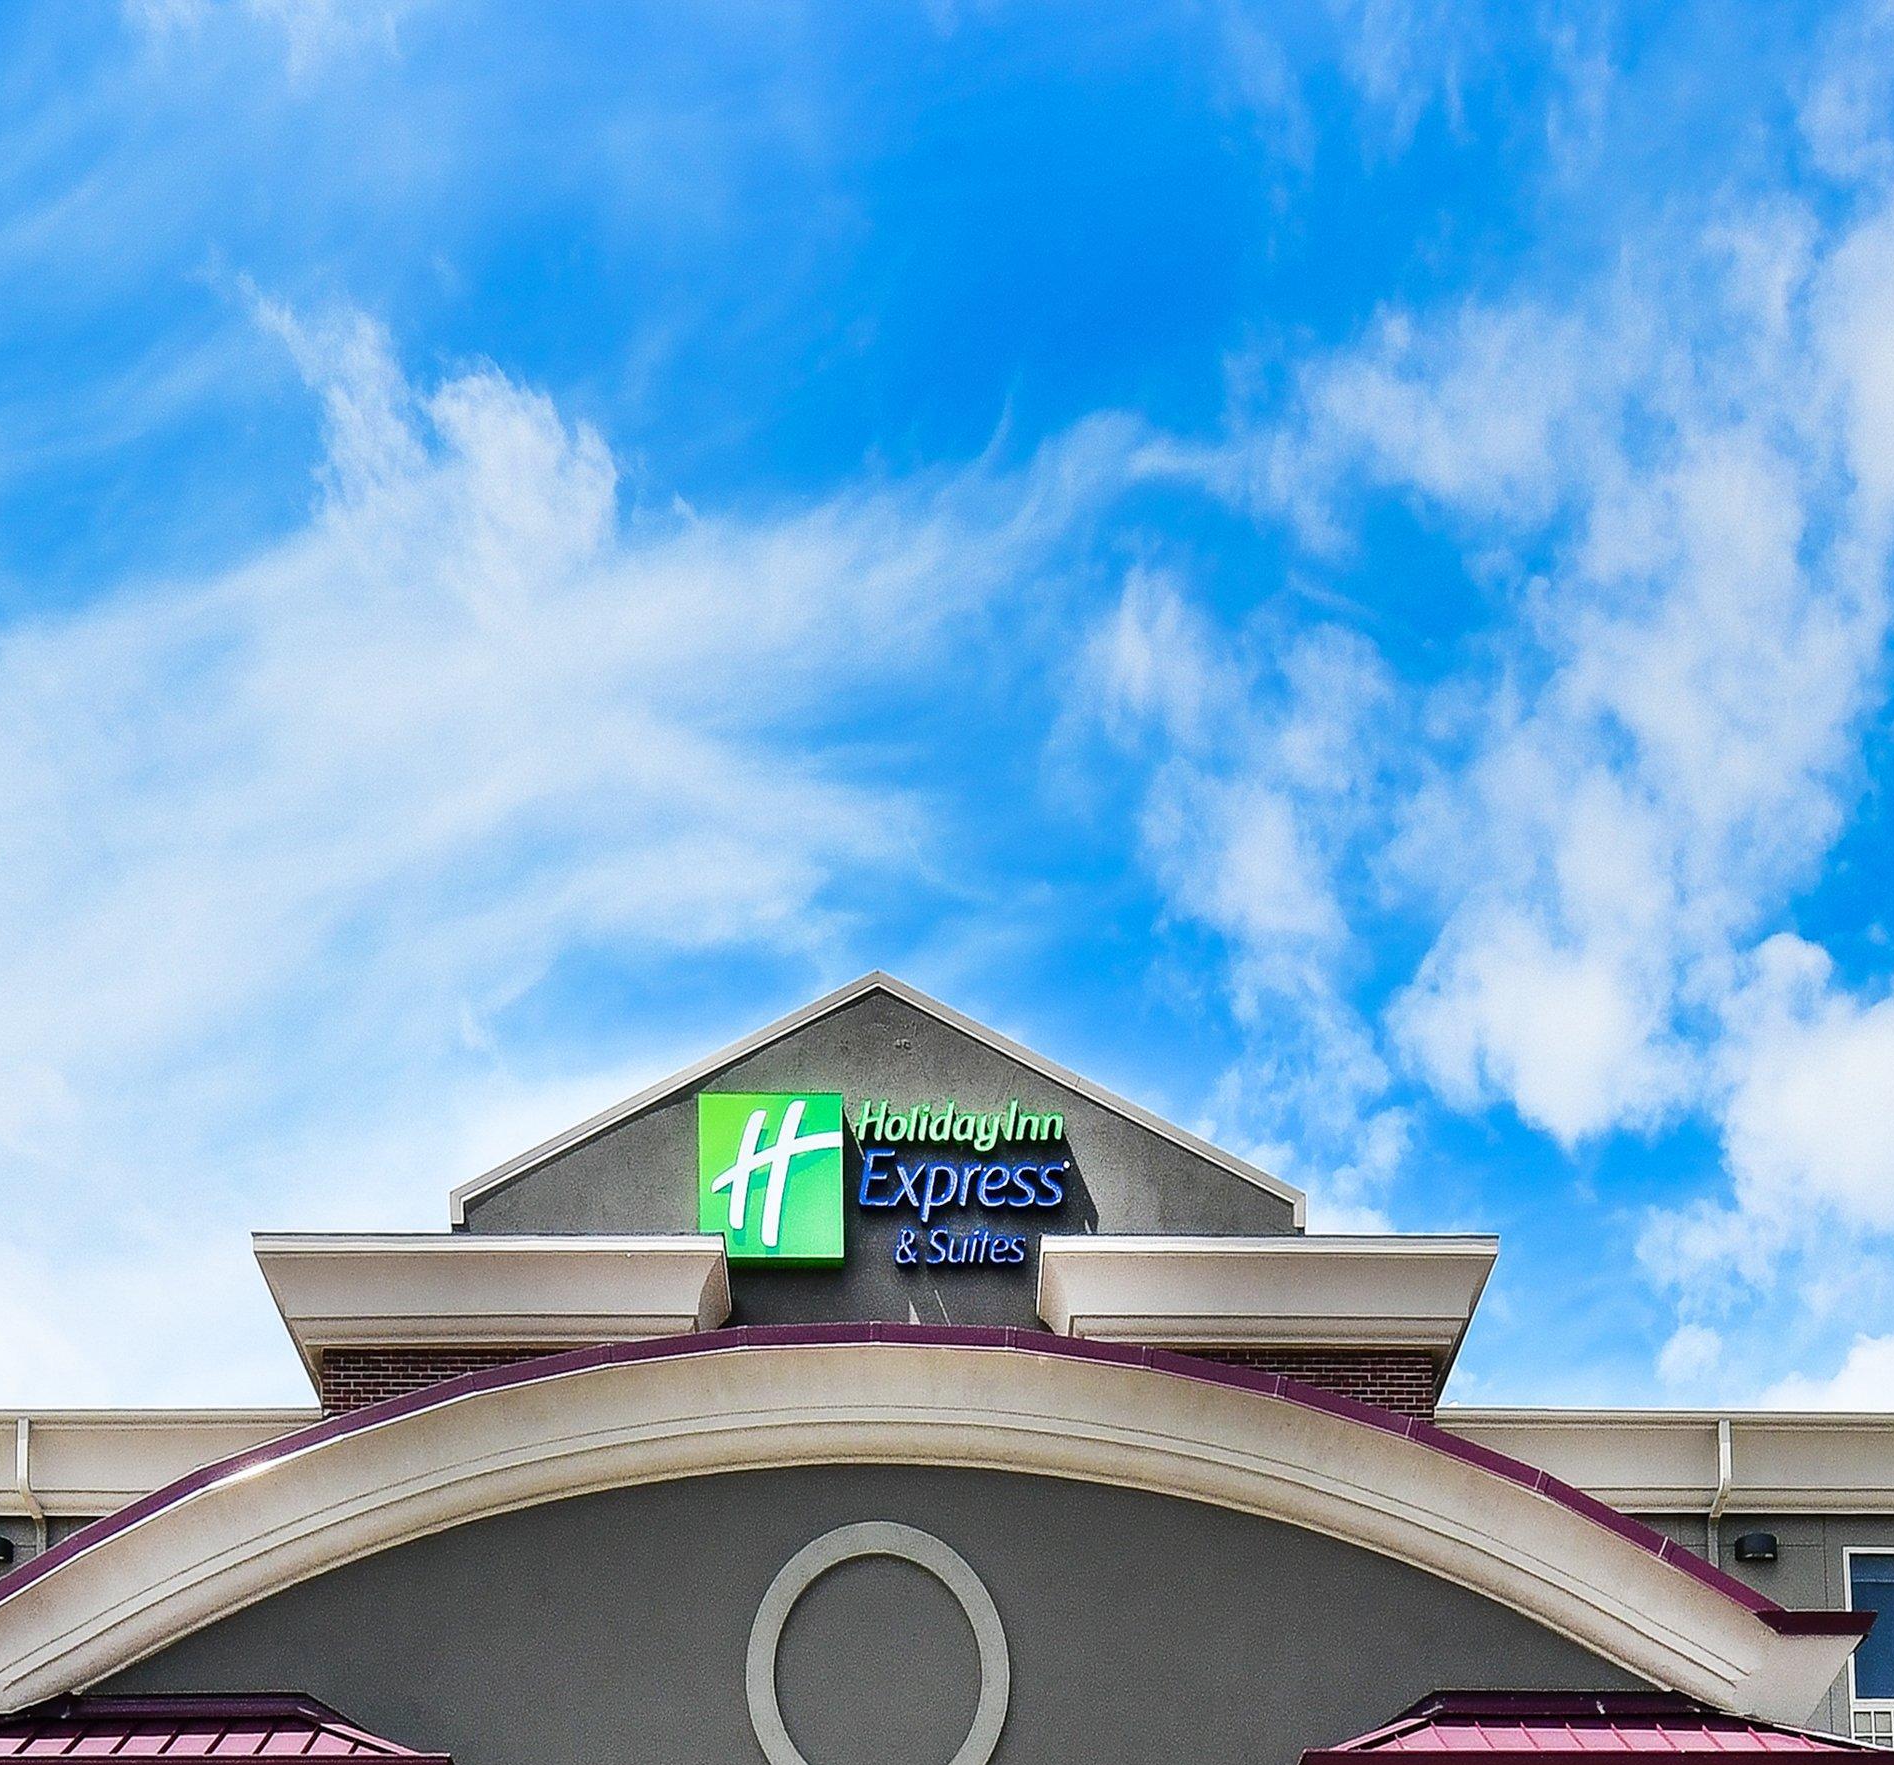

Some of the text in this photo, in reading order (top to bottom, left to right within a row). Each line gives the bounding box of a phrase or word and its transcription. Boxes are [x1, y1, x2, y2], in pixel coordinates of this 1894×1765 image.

[859, 1148, 1064, 1223] Express
[894, 1225, 1026, 1264] & Suites
